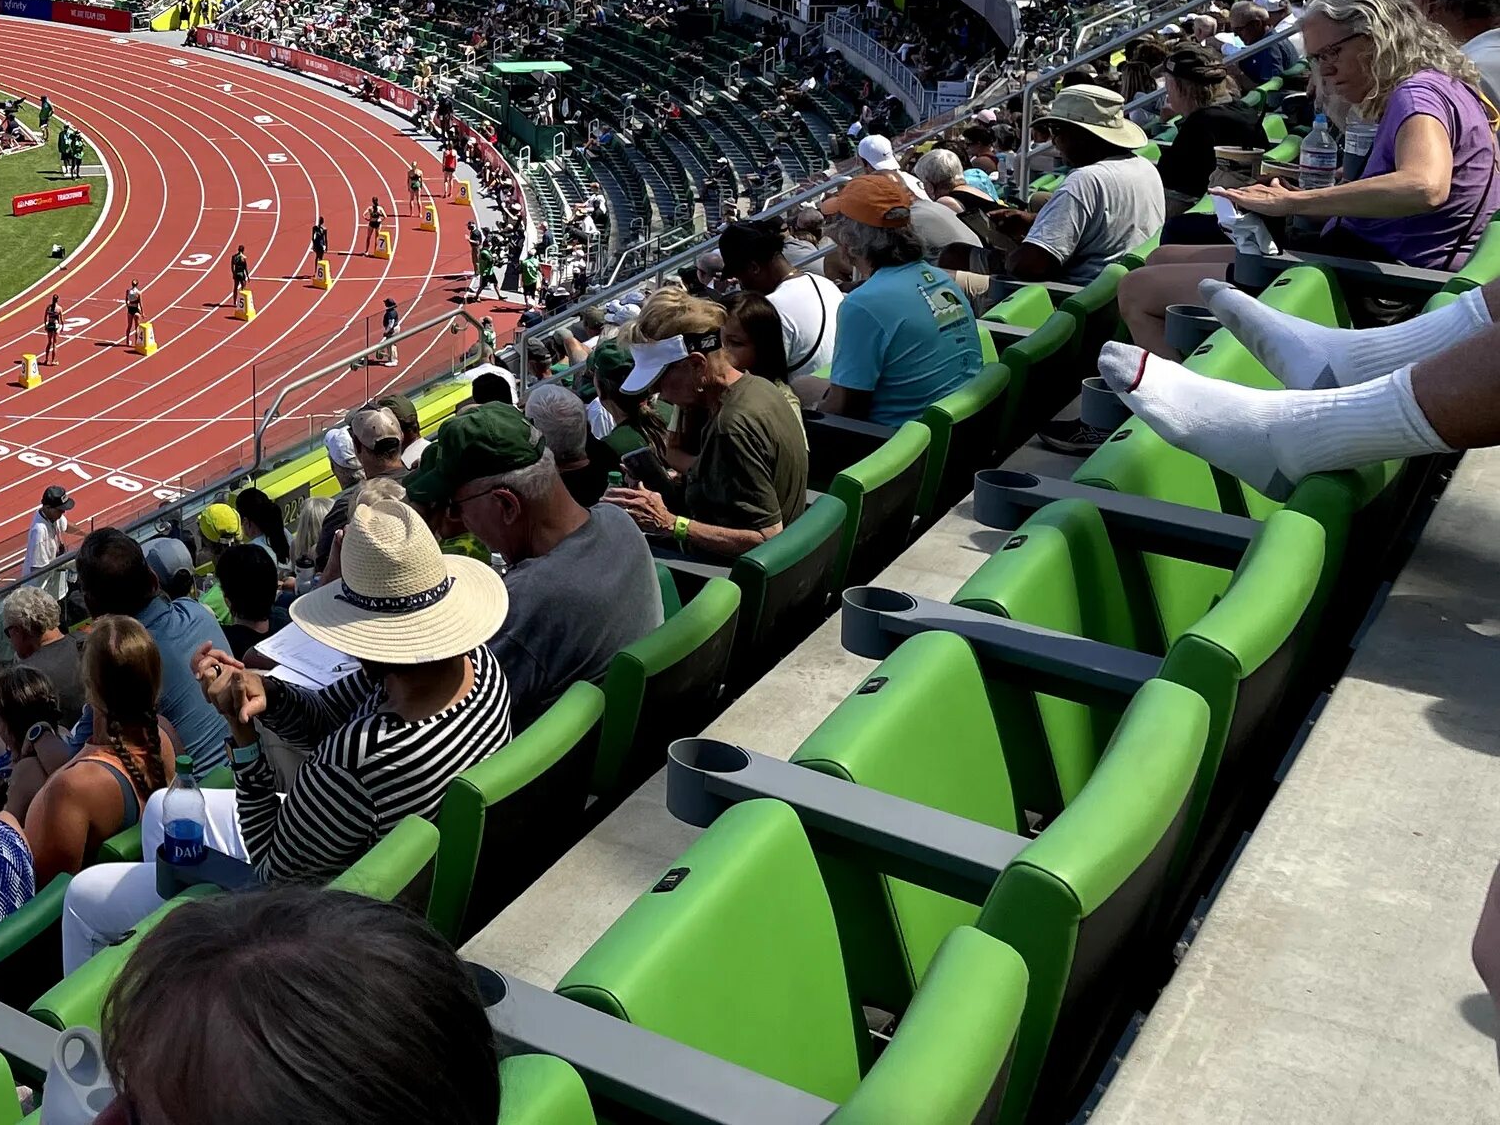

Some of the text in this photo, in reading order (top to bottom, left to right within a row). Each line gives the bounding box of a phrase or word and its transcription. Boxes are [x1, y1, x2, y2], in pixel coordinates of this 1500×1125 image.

[4, 0, 27, 11] xfinity
[253, 115, 273, 124] 6
[267, 153, 288, 163] 5
[460, 187, 466, 196] 9
[246, 198, 272, 209] 4
[426, 212, 431, 221] 8
[379, 239, 385, 248] 7
[181, 253, 212, 265] 3
[318, 268, 323, 278] 6
[239, 298, 244, 308] 5
[61, 317, 90, 331] 2
[32, 360, 37, 373] 3
[18, 452, 53, 467] 6
[57, 463, 92, 481] 7
[106, 476, 143, 492] 8
